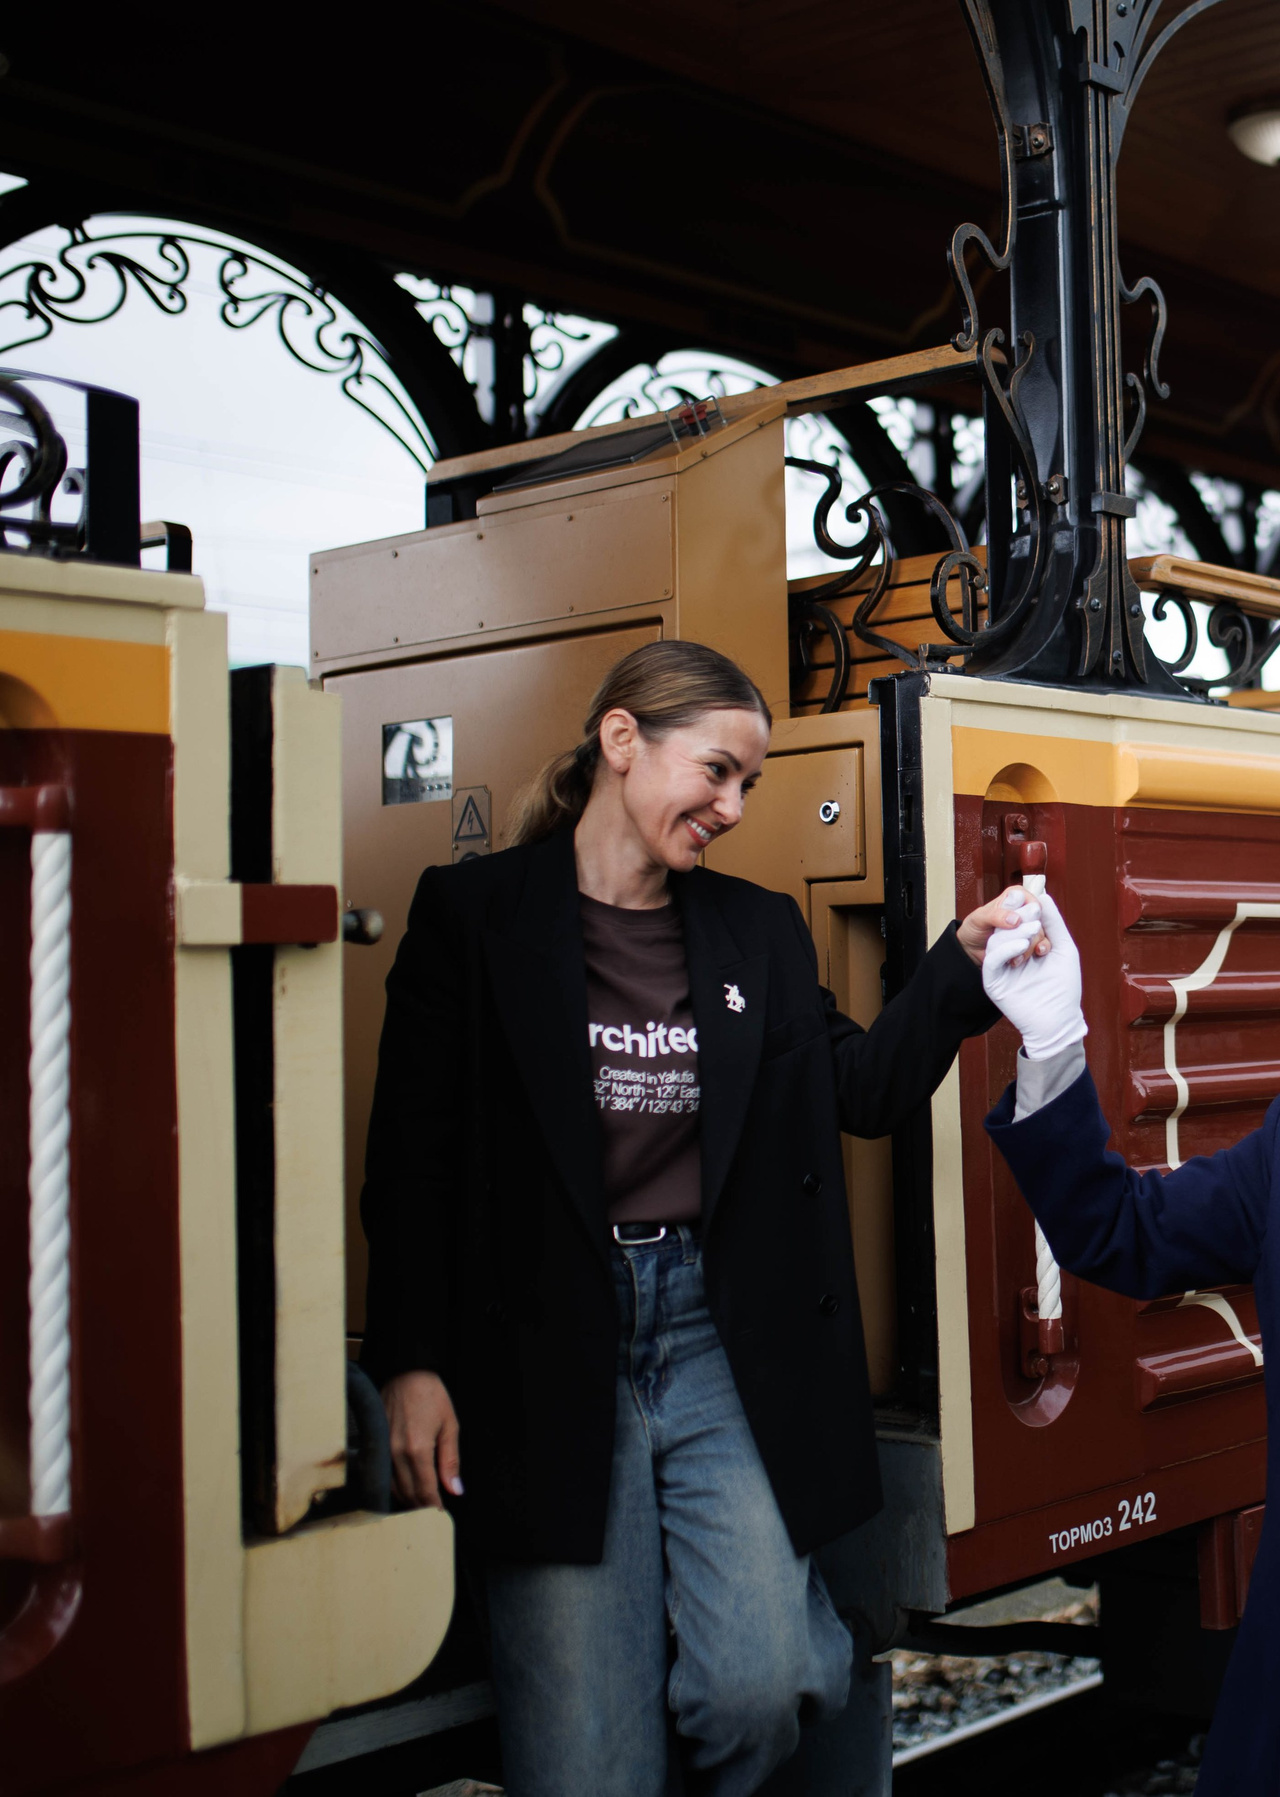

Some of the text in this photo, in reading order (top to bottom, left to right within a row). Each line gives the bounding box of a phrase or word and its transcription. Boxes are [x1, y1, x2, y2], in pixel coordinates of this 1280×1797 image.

[599, 1065, 695, 1085] Created in Yakutia
[611, 1082, 646, 1097] North
[656, 1084, 680, 1099] 129°
[679, 1084, 701, 1099] East
[1048, 1491, 1157, 1554] ТОРМОЗ 242
